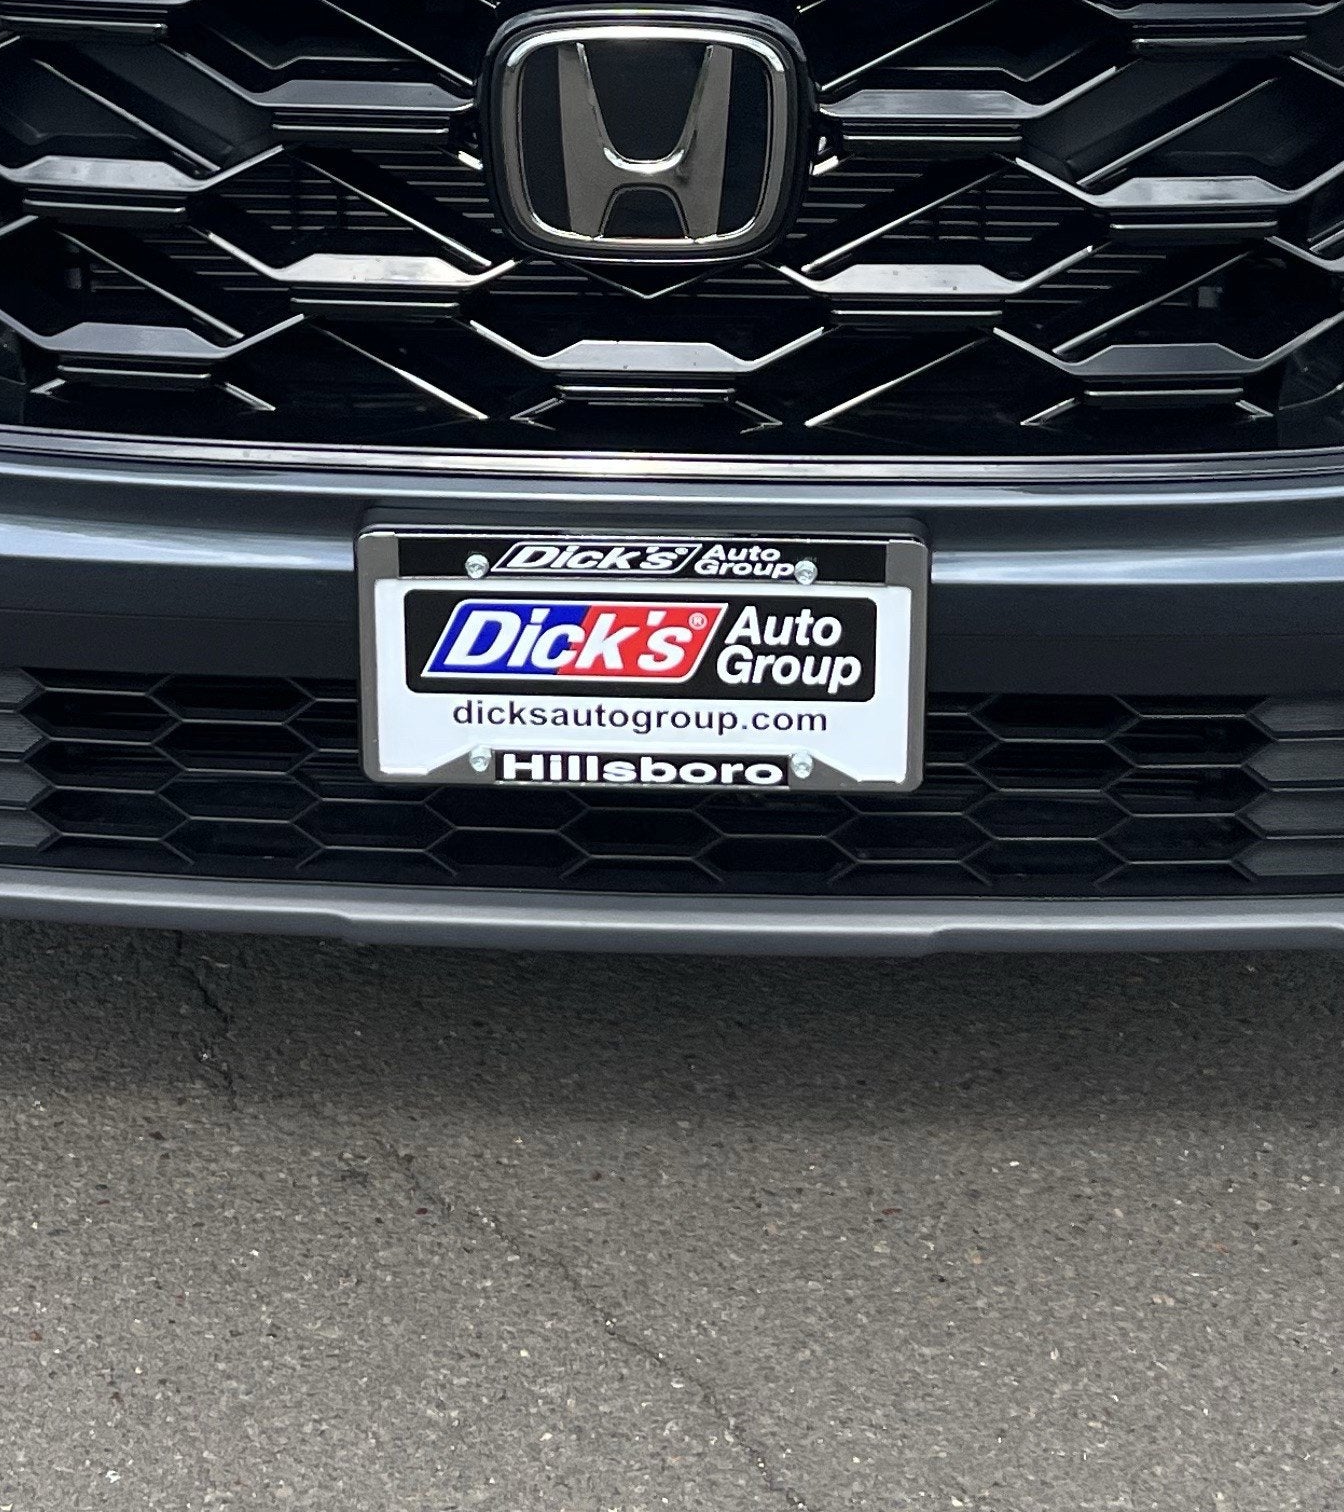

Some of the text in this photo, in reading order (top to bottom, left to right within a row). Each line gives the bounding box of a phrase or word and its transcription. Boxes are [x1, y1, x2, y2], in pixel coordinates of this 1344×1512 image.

[694, 559, 794, 579] Group
[701, 544, 781, 561] Auto
[725, 605, 843, 646] Auto
[717, 645, 862, 693] Group
[453, 700, 828, 735] dicksautogroup.com
[503, 753, 783, 785] Hillsboro
